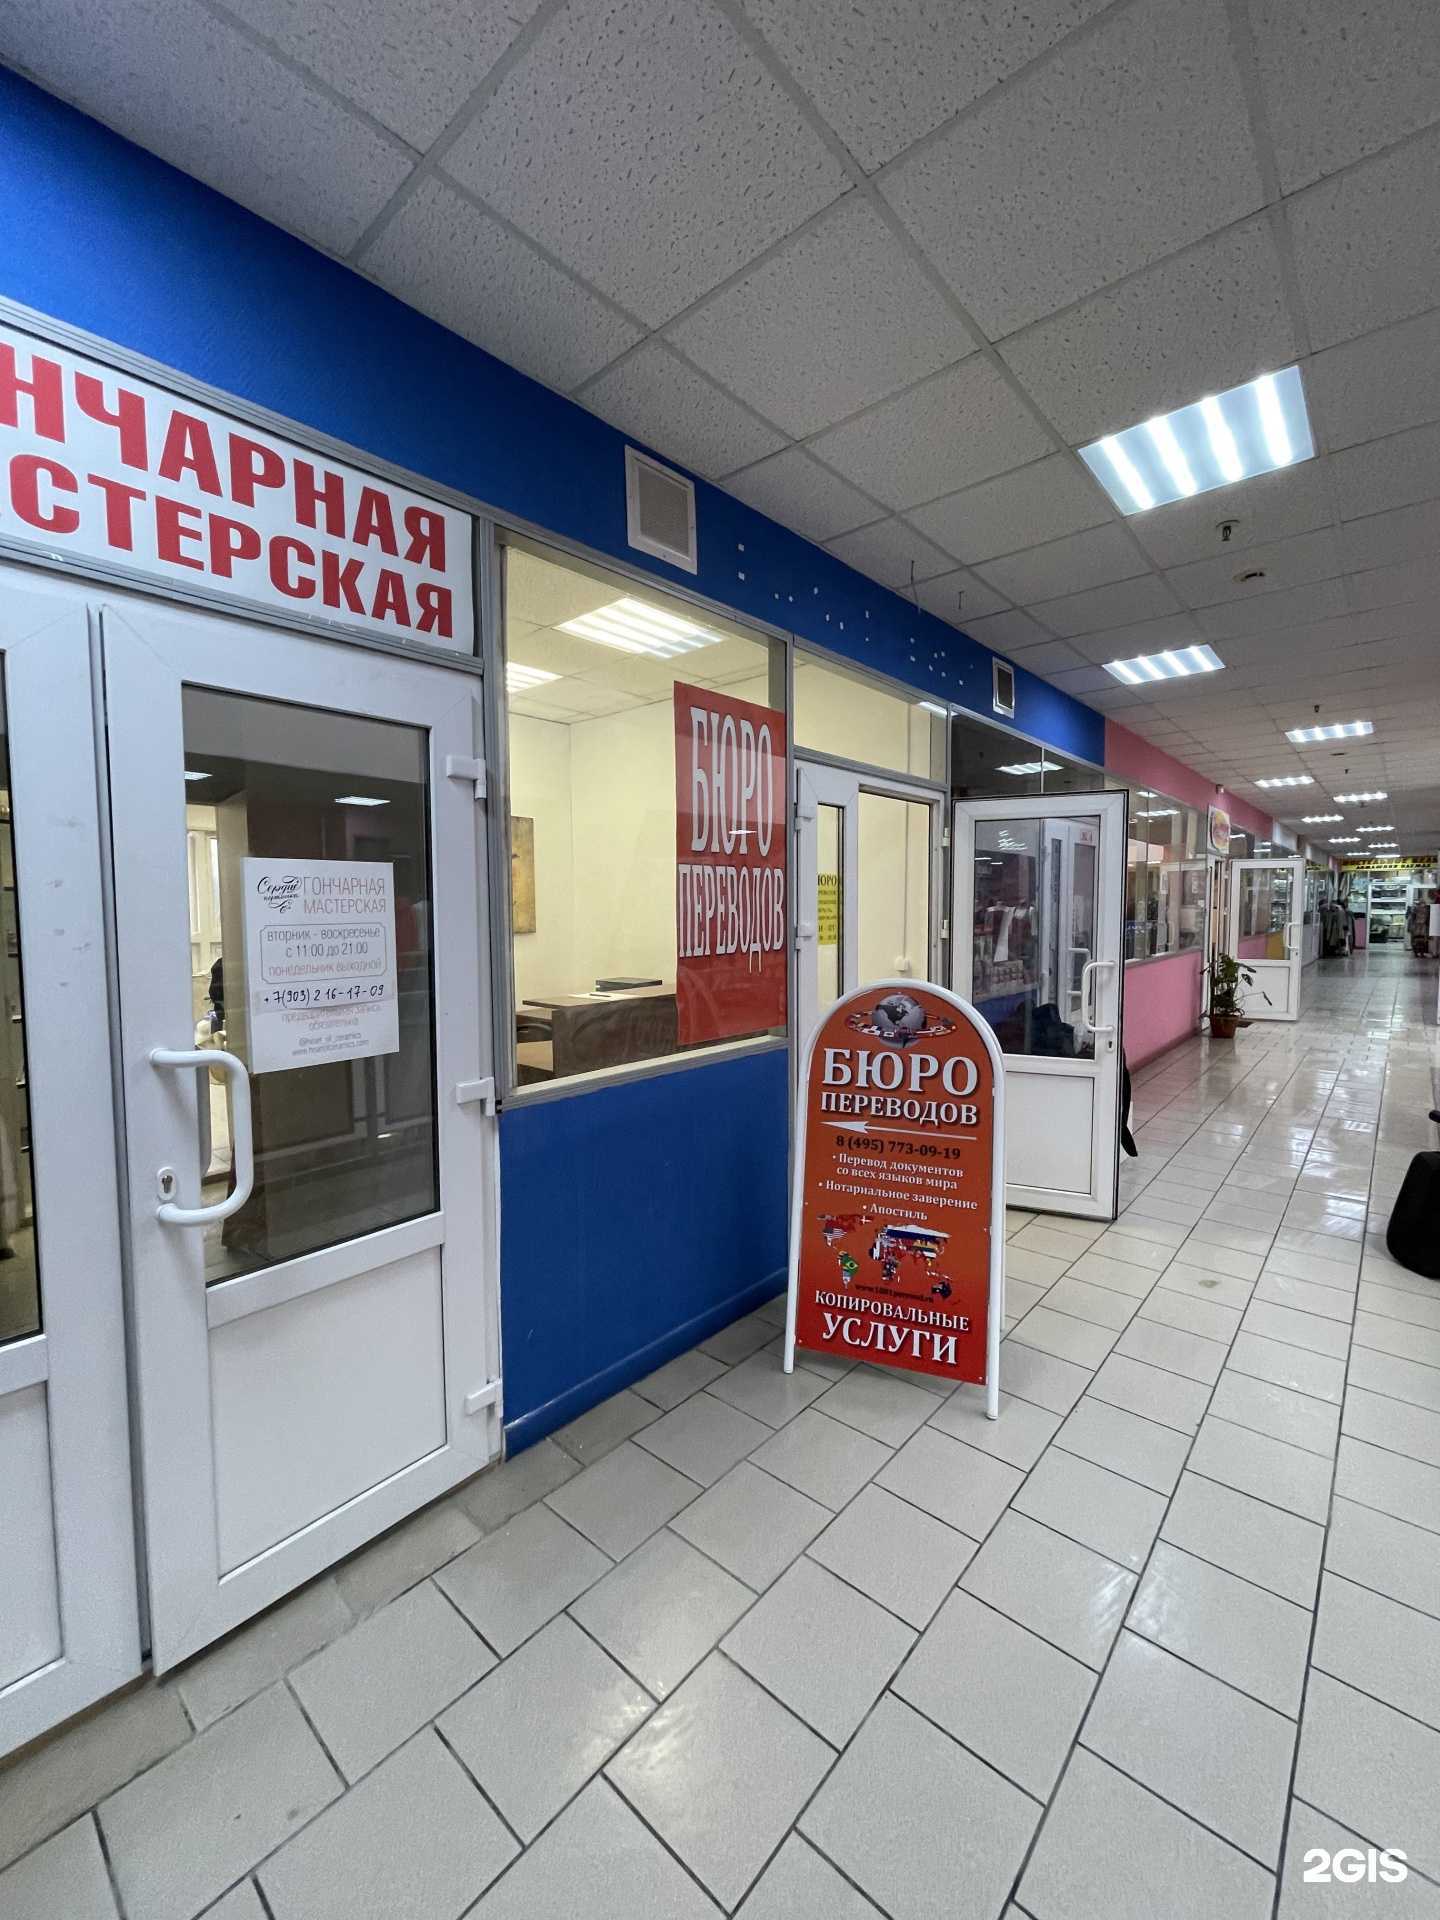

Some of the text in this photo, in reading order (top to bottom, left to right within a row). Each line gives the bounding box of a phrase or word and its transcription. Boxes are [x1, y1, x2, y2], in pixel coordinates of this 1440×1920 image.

[690, 706, 774, 857] БЮРО
[303, 876, 385, 896] ГОНЧАРНАЯ
[817, 873, 838, 887] ЮРО
[303, 898, 386, 914] МАСТЕРСКАЯ
[678, 863, 785, 974] ПЕРЕВОДОВ
[822, 1047, 978, 1096] БЮРО
[820, 1091, 977, 1126] ПЕРЕВОДОВ
[836, 1135, 844, 1147] 8
[888, 1140, 961, 1160] 773-09-19
[836, 1166, 958, 1191] со всех языков мира
[839, 1153, 964, 1178] Перевод документов
[826, 1180, 978, 1210] Нотариальное заверение
[870, 1203, 928, 1220] Апостиль
[815, 1290, 969, 1332] КОПИРОВАЛЬНЫЕ
[822, 1312, 958, 1365] УСЛУГИ
